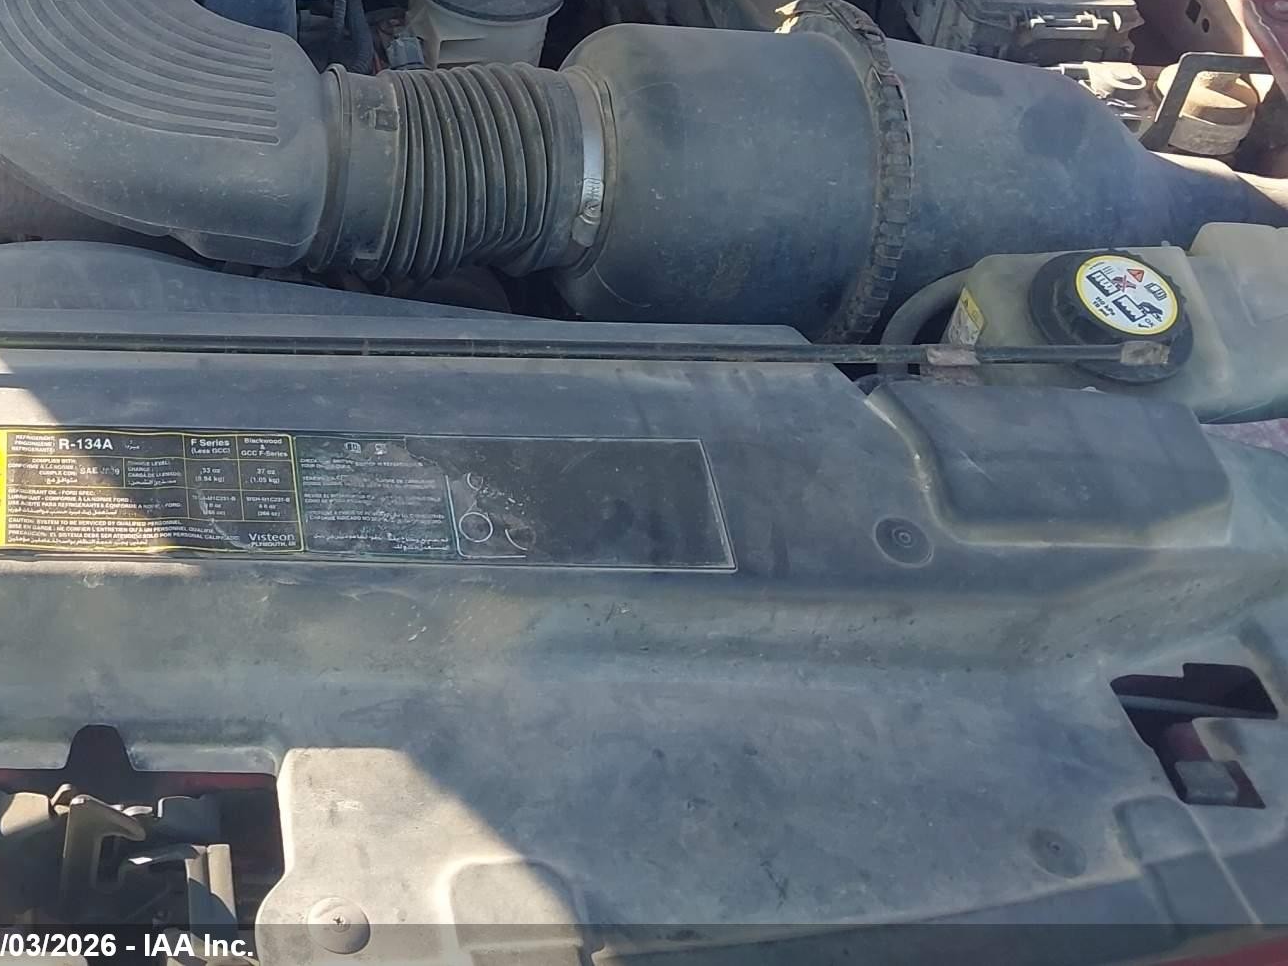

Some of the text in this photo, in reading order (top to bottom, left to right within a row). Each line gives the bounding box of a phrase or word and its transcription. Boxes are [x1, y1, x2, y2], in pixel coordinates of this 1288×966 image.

[58, 438, 114, 450] R-134A
[191, 438, 230, 446] F Series
[79, 467, 98, 475] SAE
[248, 532, 295, 541] Visteon
